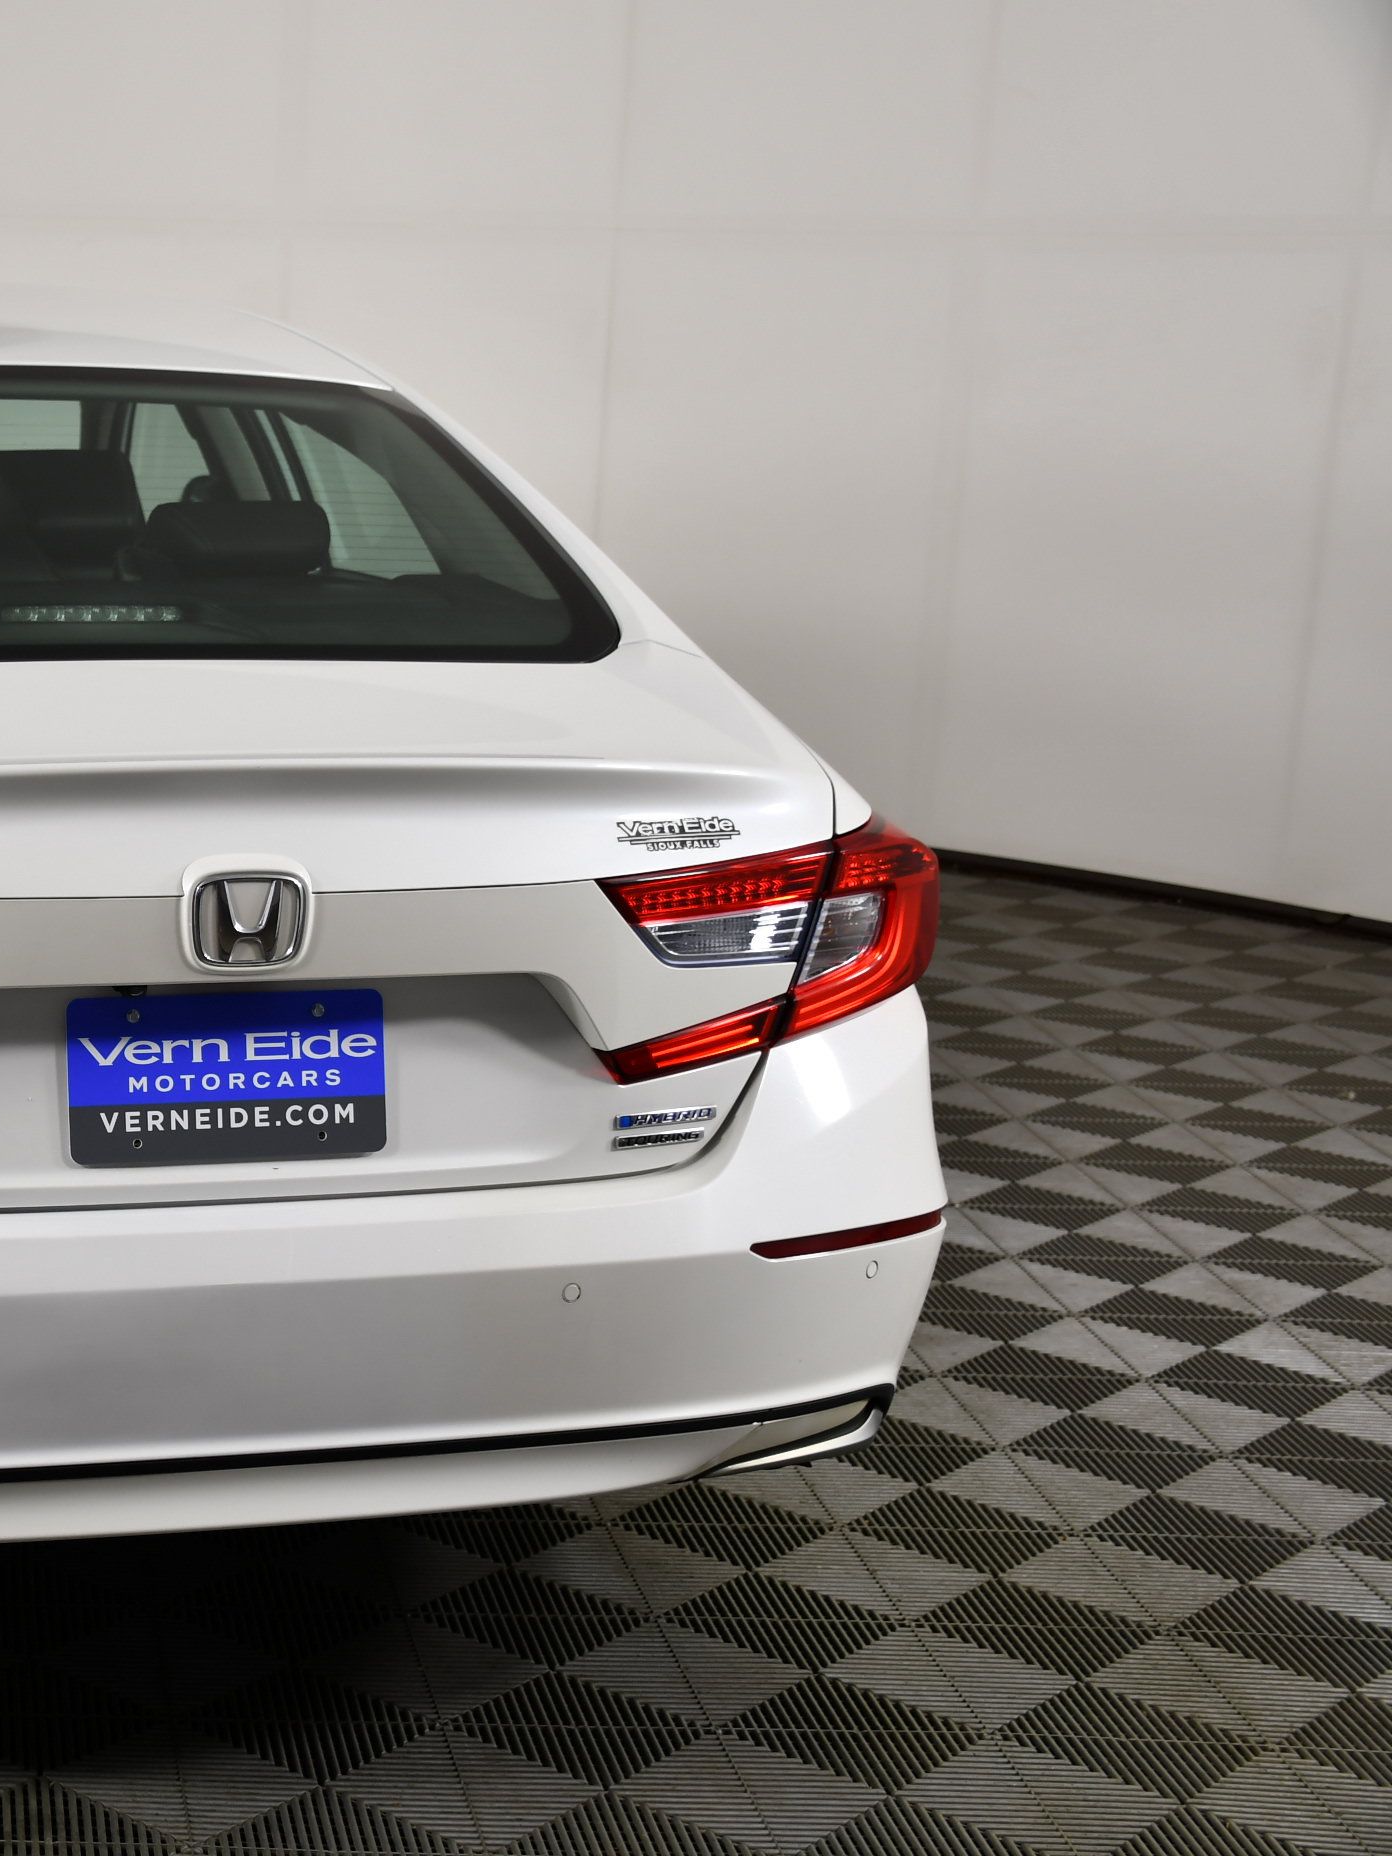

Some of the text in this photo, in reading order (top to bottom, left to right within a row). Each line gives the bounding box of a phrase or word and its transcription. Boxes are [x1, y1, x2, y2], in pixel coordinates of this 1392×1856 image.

[616, 816, 736, 837] Vern Eide
[646, 839, 720, 851] SIOUX FALLS
[77, 1029, 377, 1067] Vern Eide
[128, 1069, 342, 1093] MOTORCARS
[99, 1103, 355, 1134] VERNEIDE.COM
[633, 1107, 713, 1127] HYBRID
